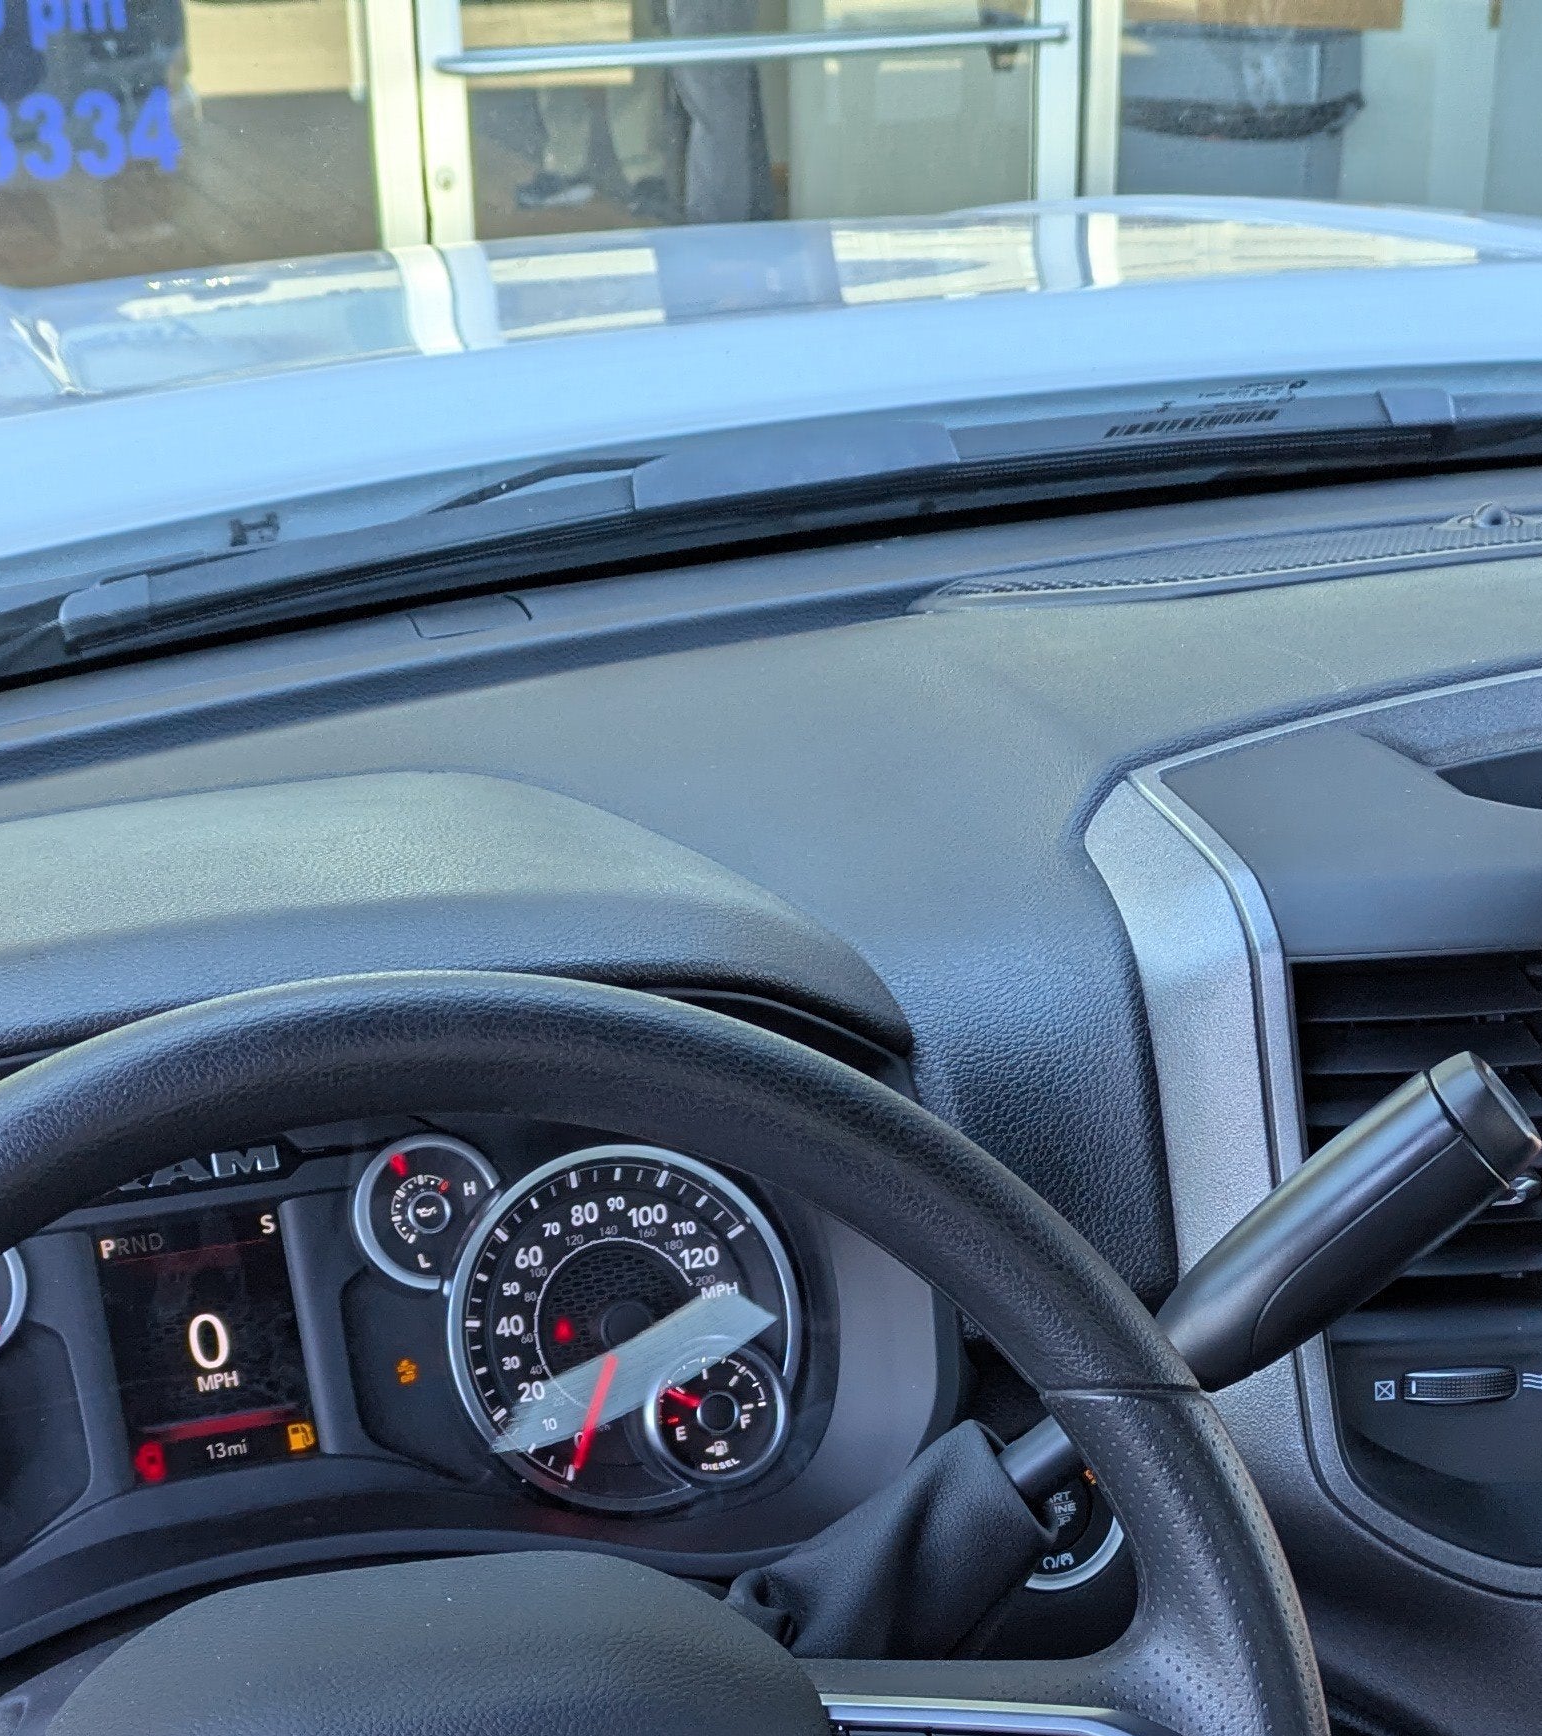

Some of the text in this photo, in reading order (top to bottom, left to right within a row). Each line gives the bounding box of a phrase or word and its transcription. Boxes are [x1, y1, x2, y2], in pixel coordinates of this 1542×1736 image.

[27, 0, 128, 50] pm
[119, 1145, 280, 1190] AM
[463, 1181, 476, 1196] H
[607, 1196, 625, 1211] 90
[571, 1201, 599, 1226] 80
[627, 1204, 667, 1228] 100
[260, 1214, 276, 1235] S
[542, 1221, 561, 1237] 70
[600, 1225, 618, 1237] 140
[671, 1220, 696, 1236] 110
[565, 1234, 584, 1246] 120
[638, 1227, 657, 1238] 160
[100, 1232, 164, 1259] PRND
[664, 1239, 683, 1250] 180
[418, 1254, 431, 1269] L
[515, 1245, 543, 1269] 60
[679, 1246, 719, 1270] 120
[530, 1267, 548, 1278] 100
[695, 1274, 716, 1286] 200
[502, 1281, 520, 1296] 50
[700, 1281, 738, 1300] MPH
[524, 1291, 537, 1302] 80
[496, 1314, 524, 1337] 40
[189, 1313, 229, 1369] 0
[521, 1333, 533, 1344] 60
[502, 1355, 520, 1370] 30
[197, 1371, 239, 1392] MPH
[517, 1380, 545, 1402] 20
[542, 1418, 557, 1431] 10
[740, 1414, 751, 1428] F
[676, 1426, 687, 1441] E
[701, 1457, 740, 1471] DIESEL
